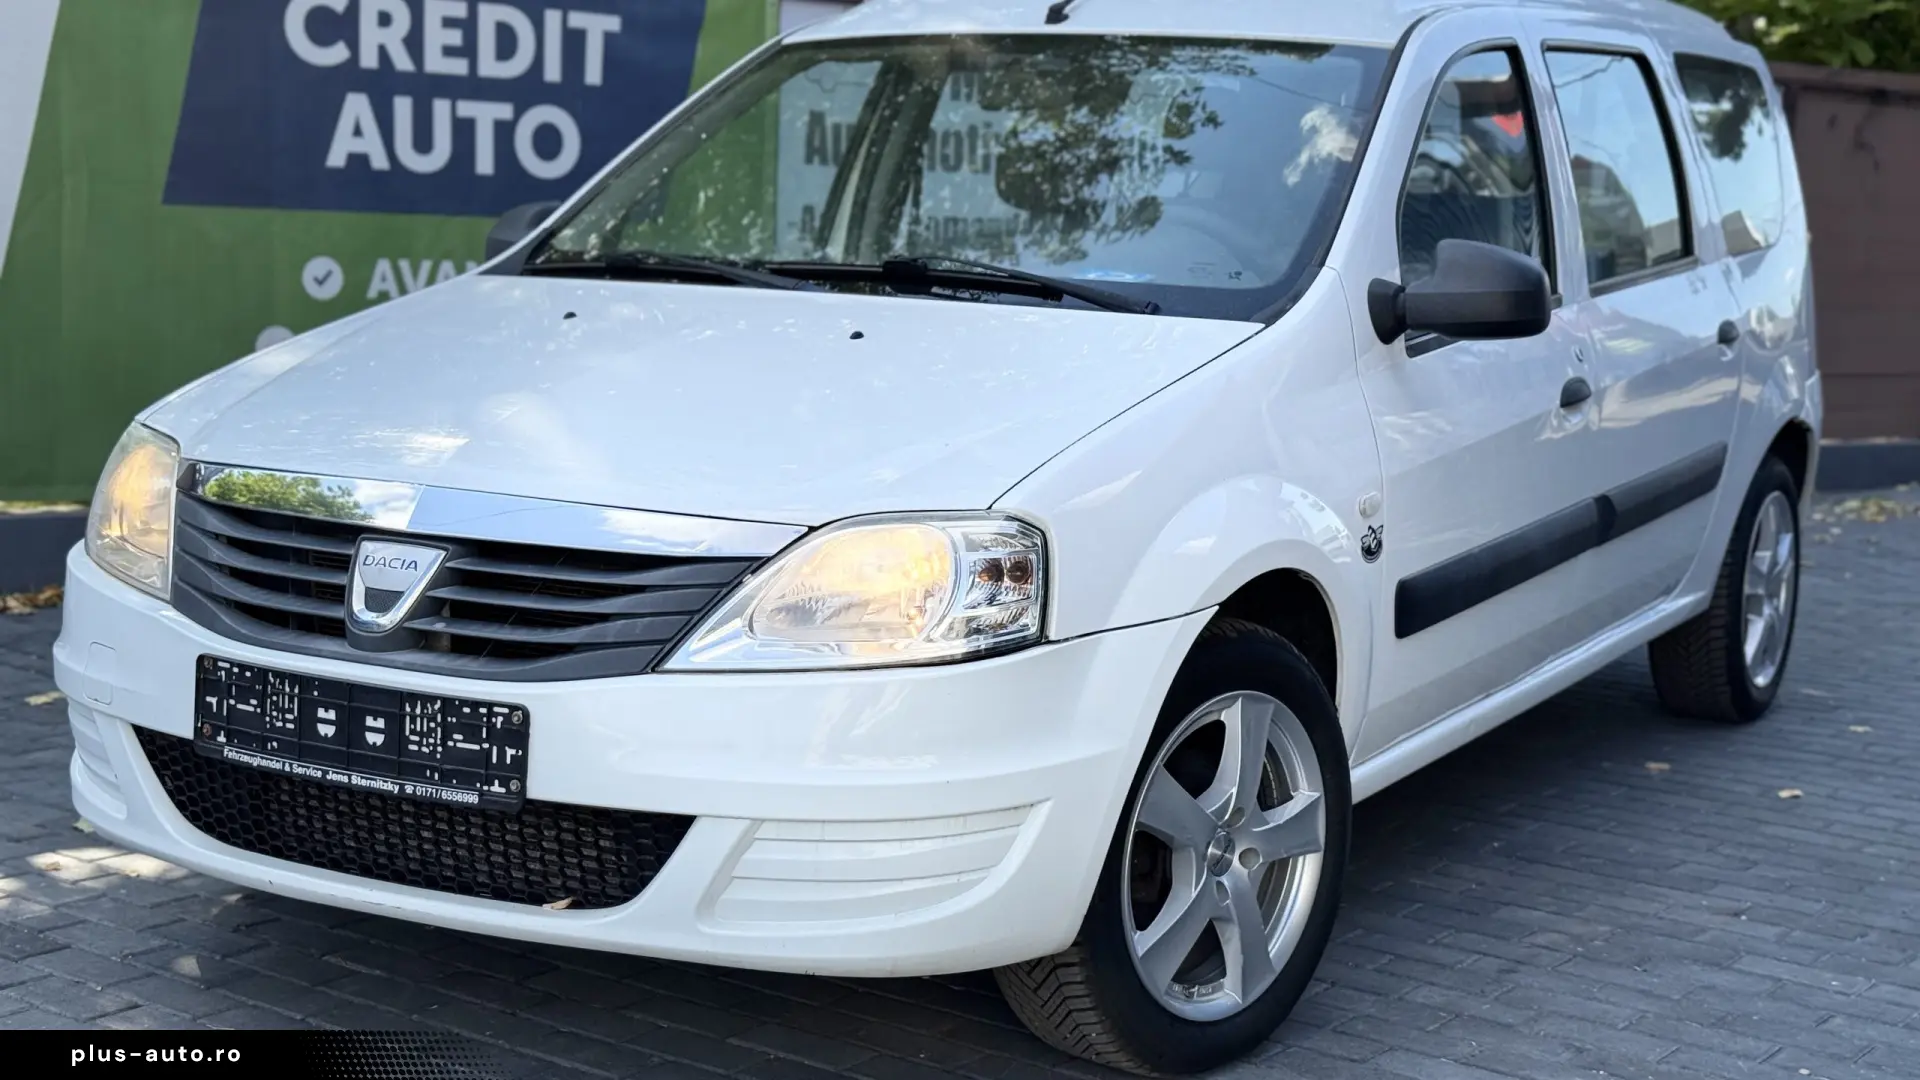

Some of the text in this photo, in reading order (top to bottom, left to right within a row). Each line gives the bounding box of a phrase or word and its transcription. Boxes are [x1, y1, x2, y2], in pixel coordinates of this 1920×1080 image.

[284, 0, 622, 87] CREDIT
[325, 92, 582, 180] AUTO
[366, 257, 478, 300] AVA
[362, 554, 418, 572] DACIA
[223, 748, 283, 770] Fahrzeughandel
[284, 762, 291, 772] &
[292, 764, 322, 778] Service
[326, 770, 349, 783] Jens
[351, 775, 400, 794] Sternitzky
